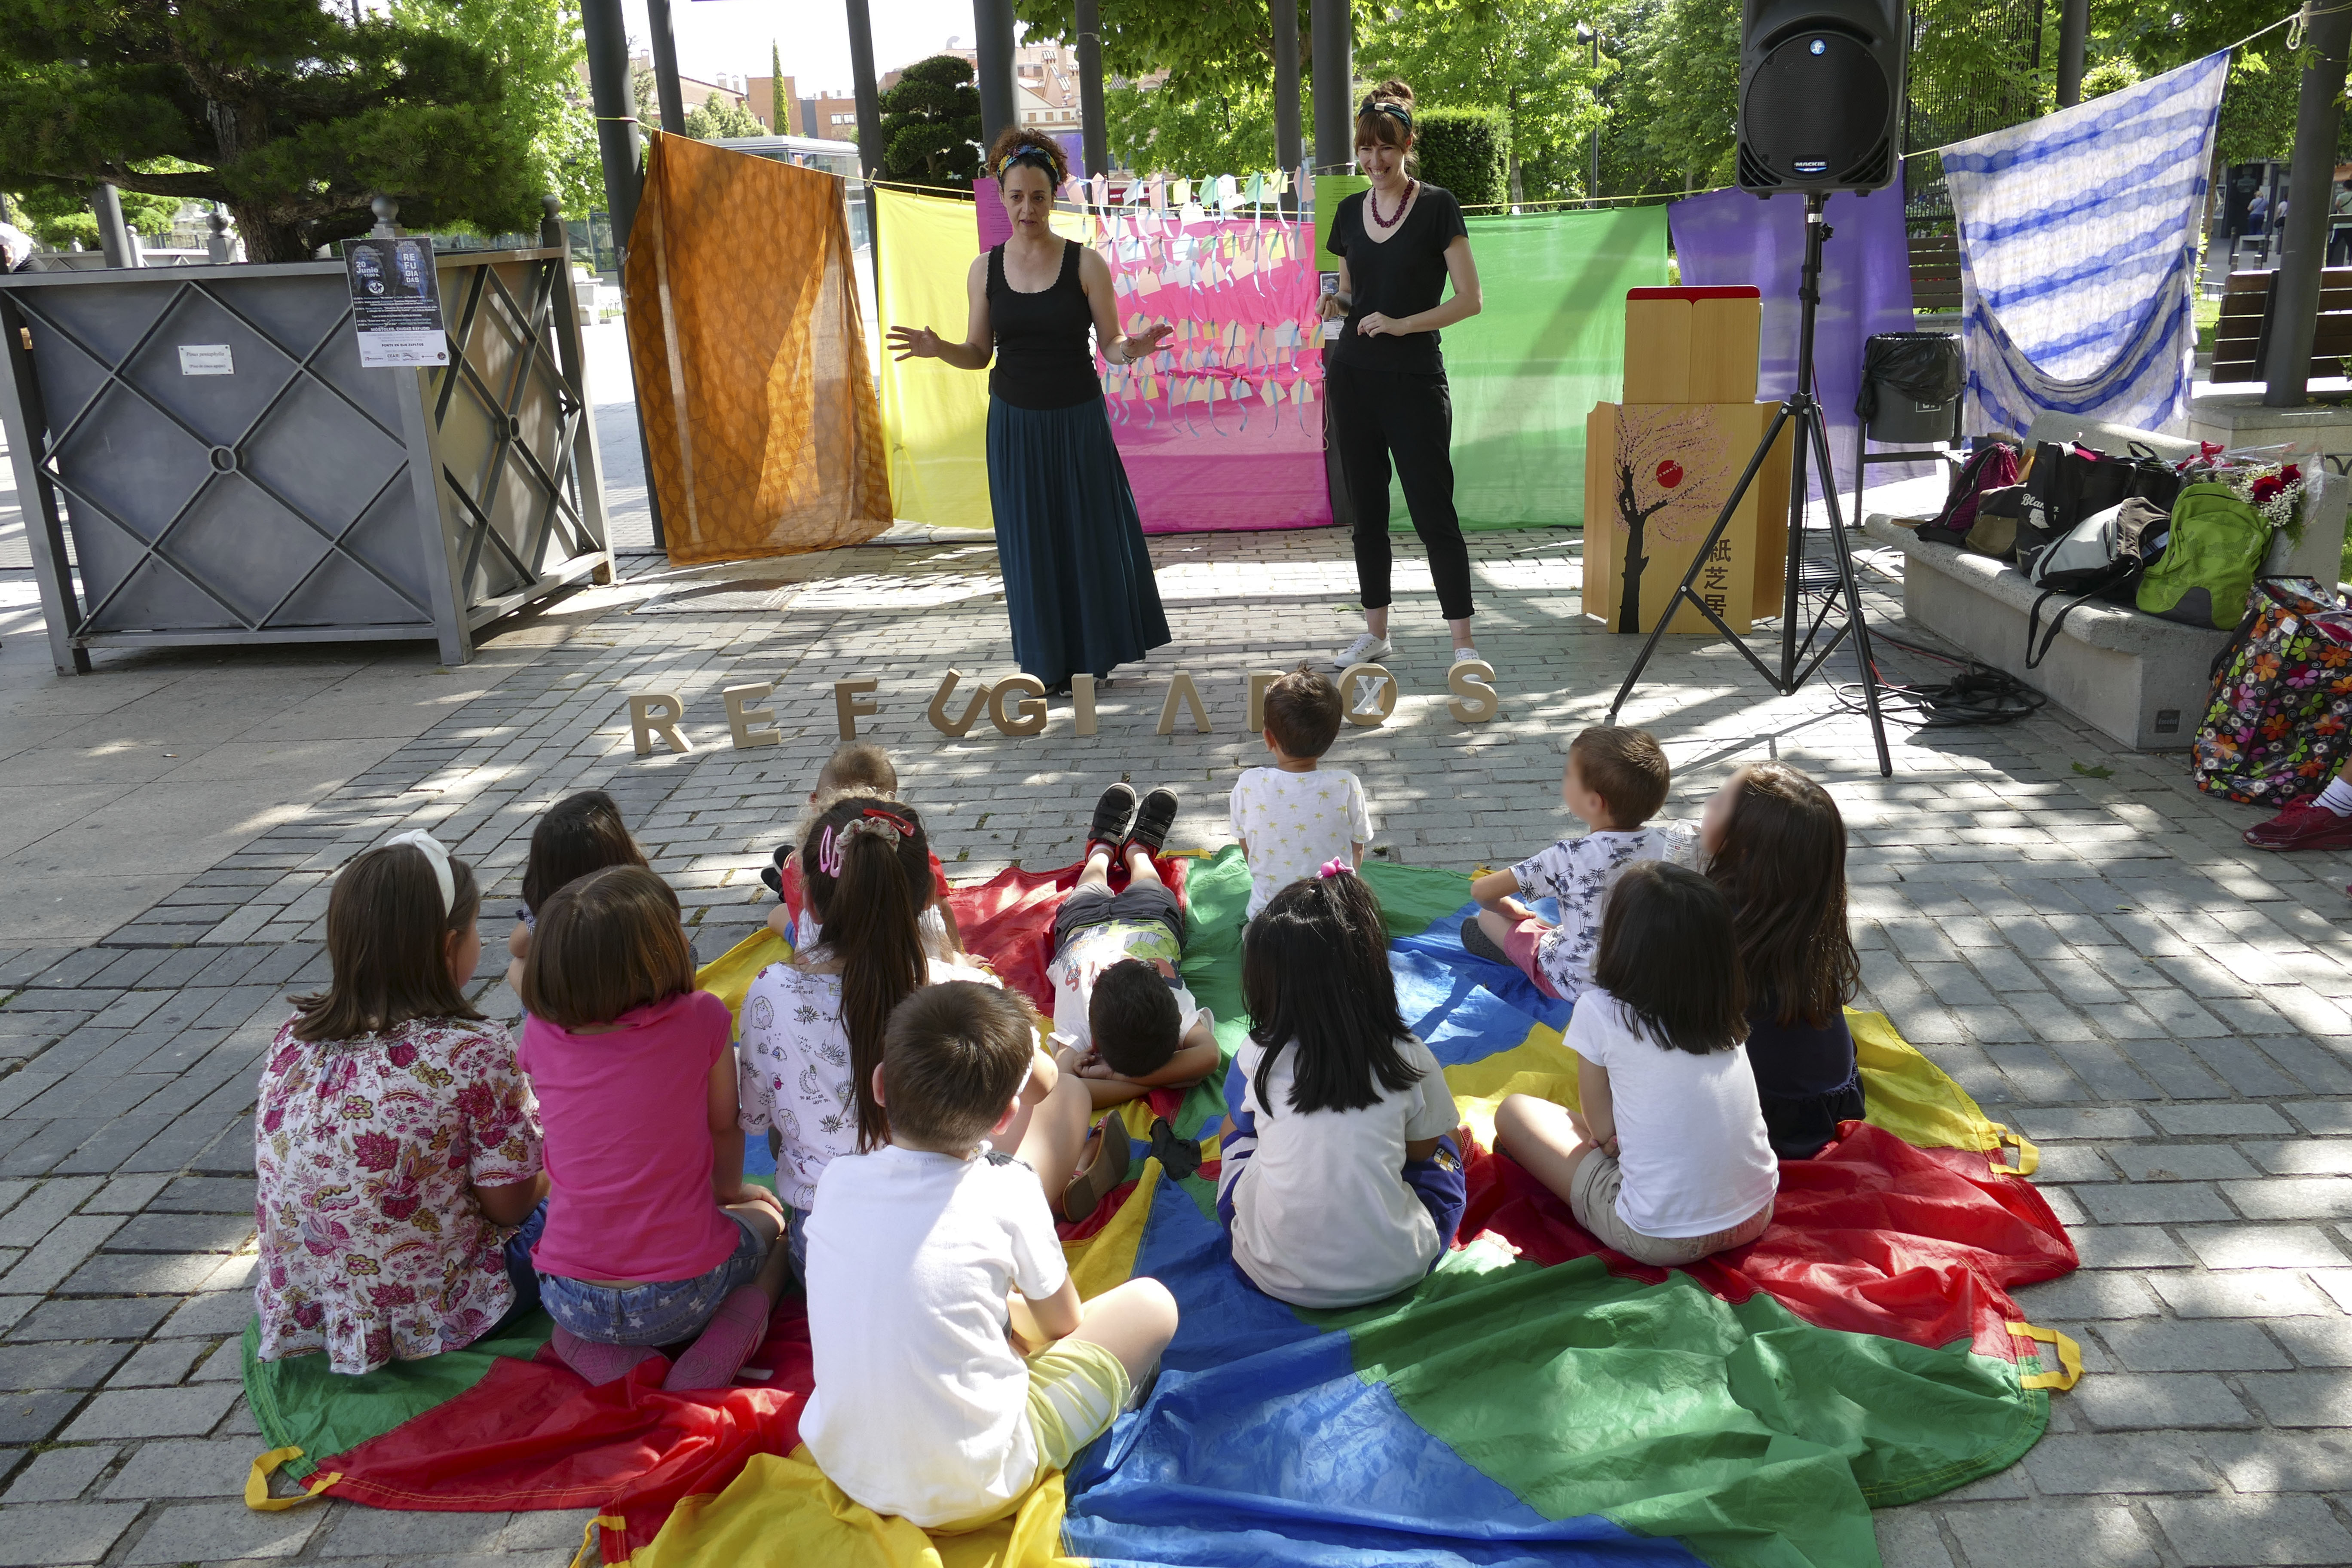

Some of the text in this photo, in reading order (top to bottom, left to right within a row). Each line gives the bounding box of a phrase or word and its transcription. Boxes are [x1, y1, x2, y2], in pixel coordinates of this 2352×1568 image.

[403, 253, 416, 261] RE
[1702, 538, 1732, 618] 紙芝居
